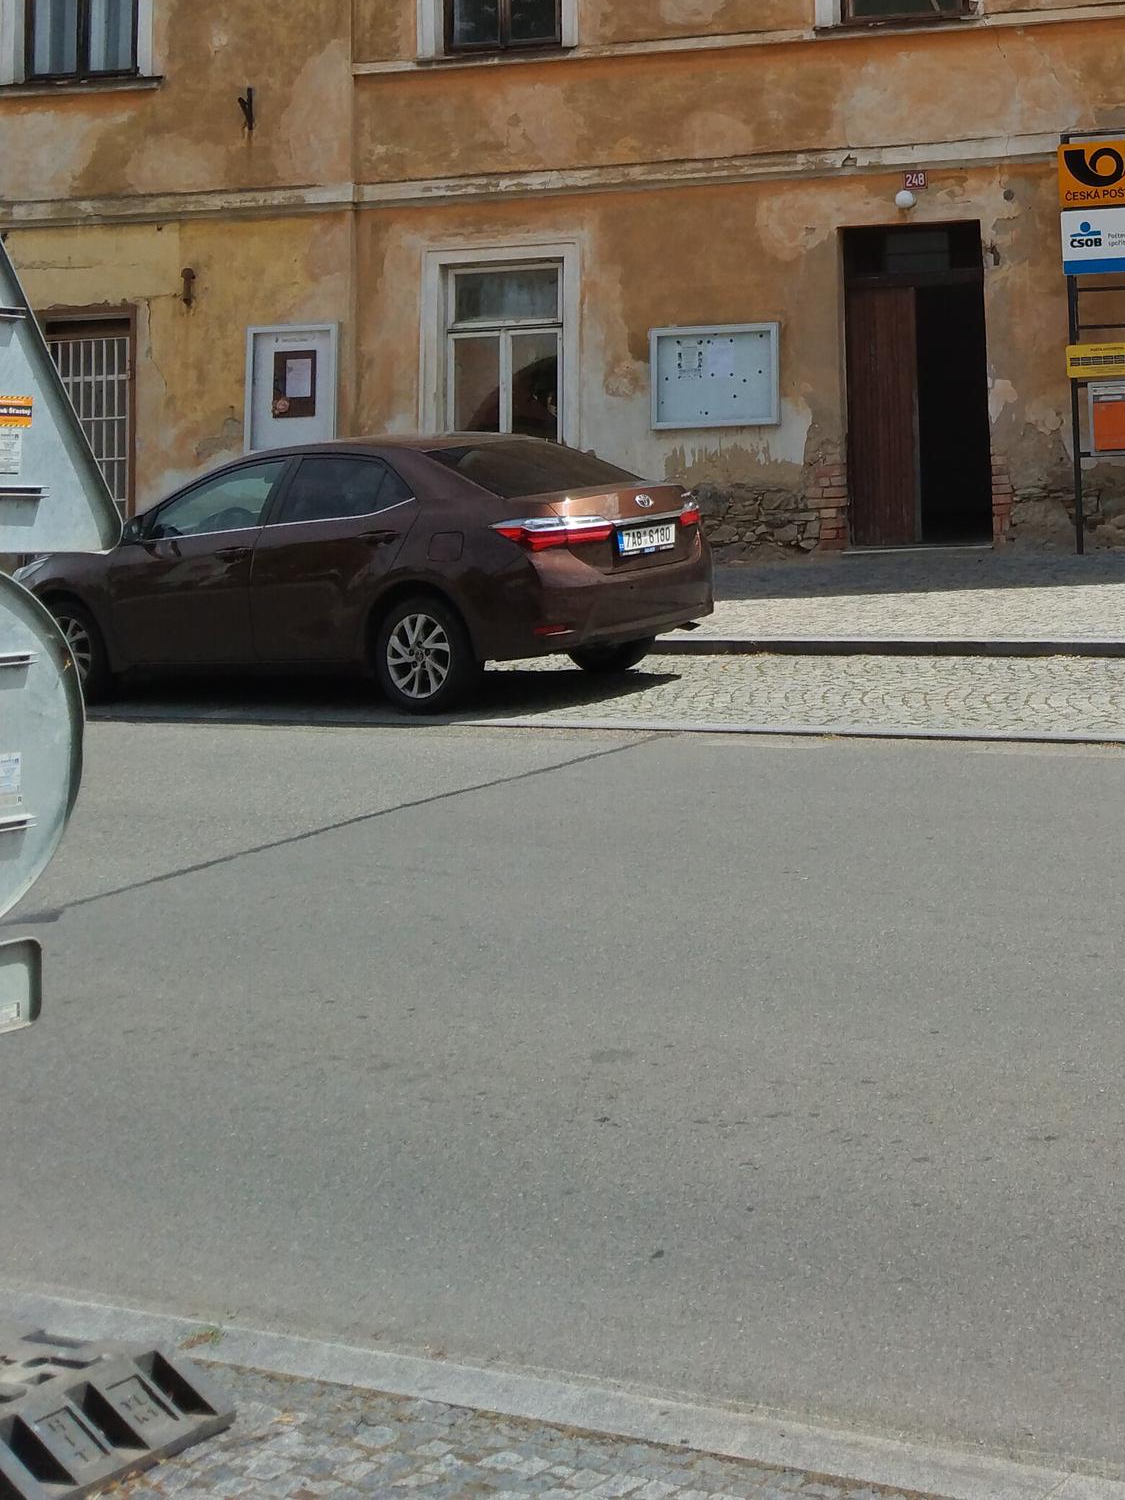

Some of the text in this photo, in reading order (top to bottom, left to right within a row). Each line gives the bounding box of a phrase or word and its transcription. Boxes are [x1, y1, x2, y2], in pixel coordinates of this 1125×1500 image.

[905, 173, 925, 187] 248
[1065, 188, 1100, 201] ČESKÁ
[1070, 237, 1102, 248] ČSOB
[625, 531, 642, 548] 7AB
[649, 527, 670, 543] 6180
